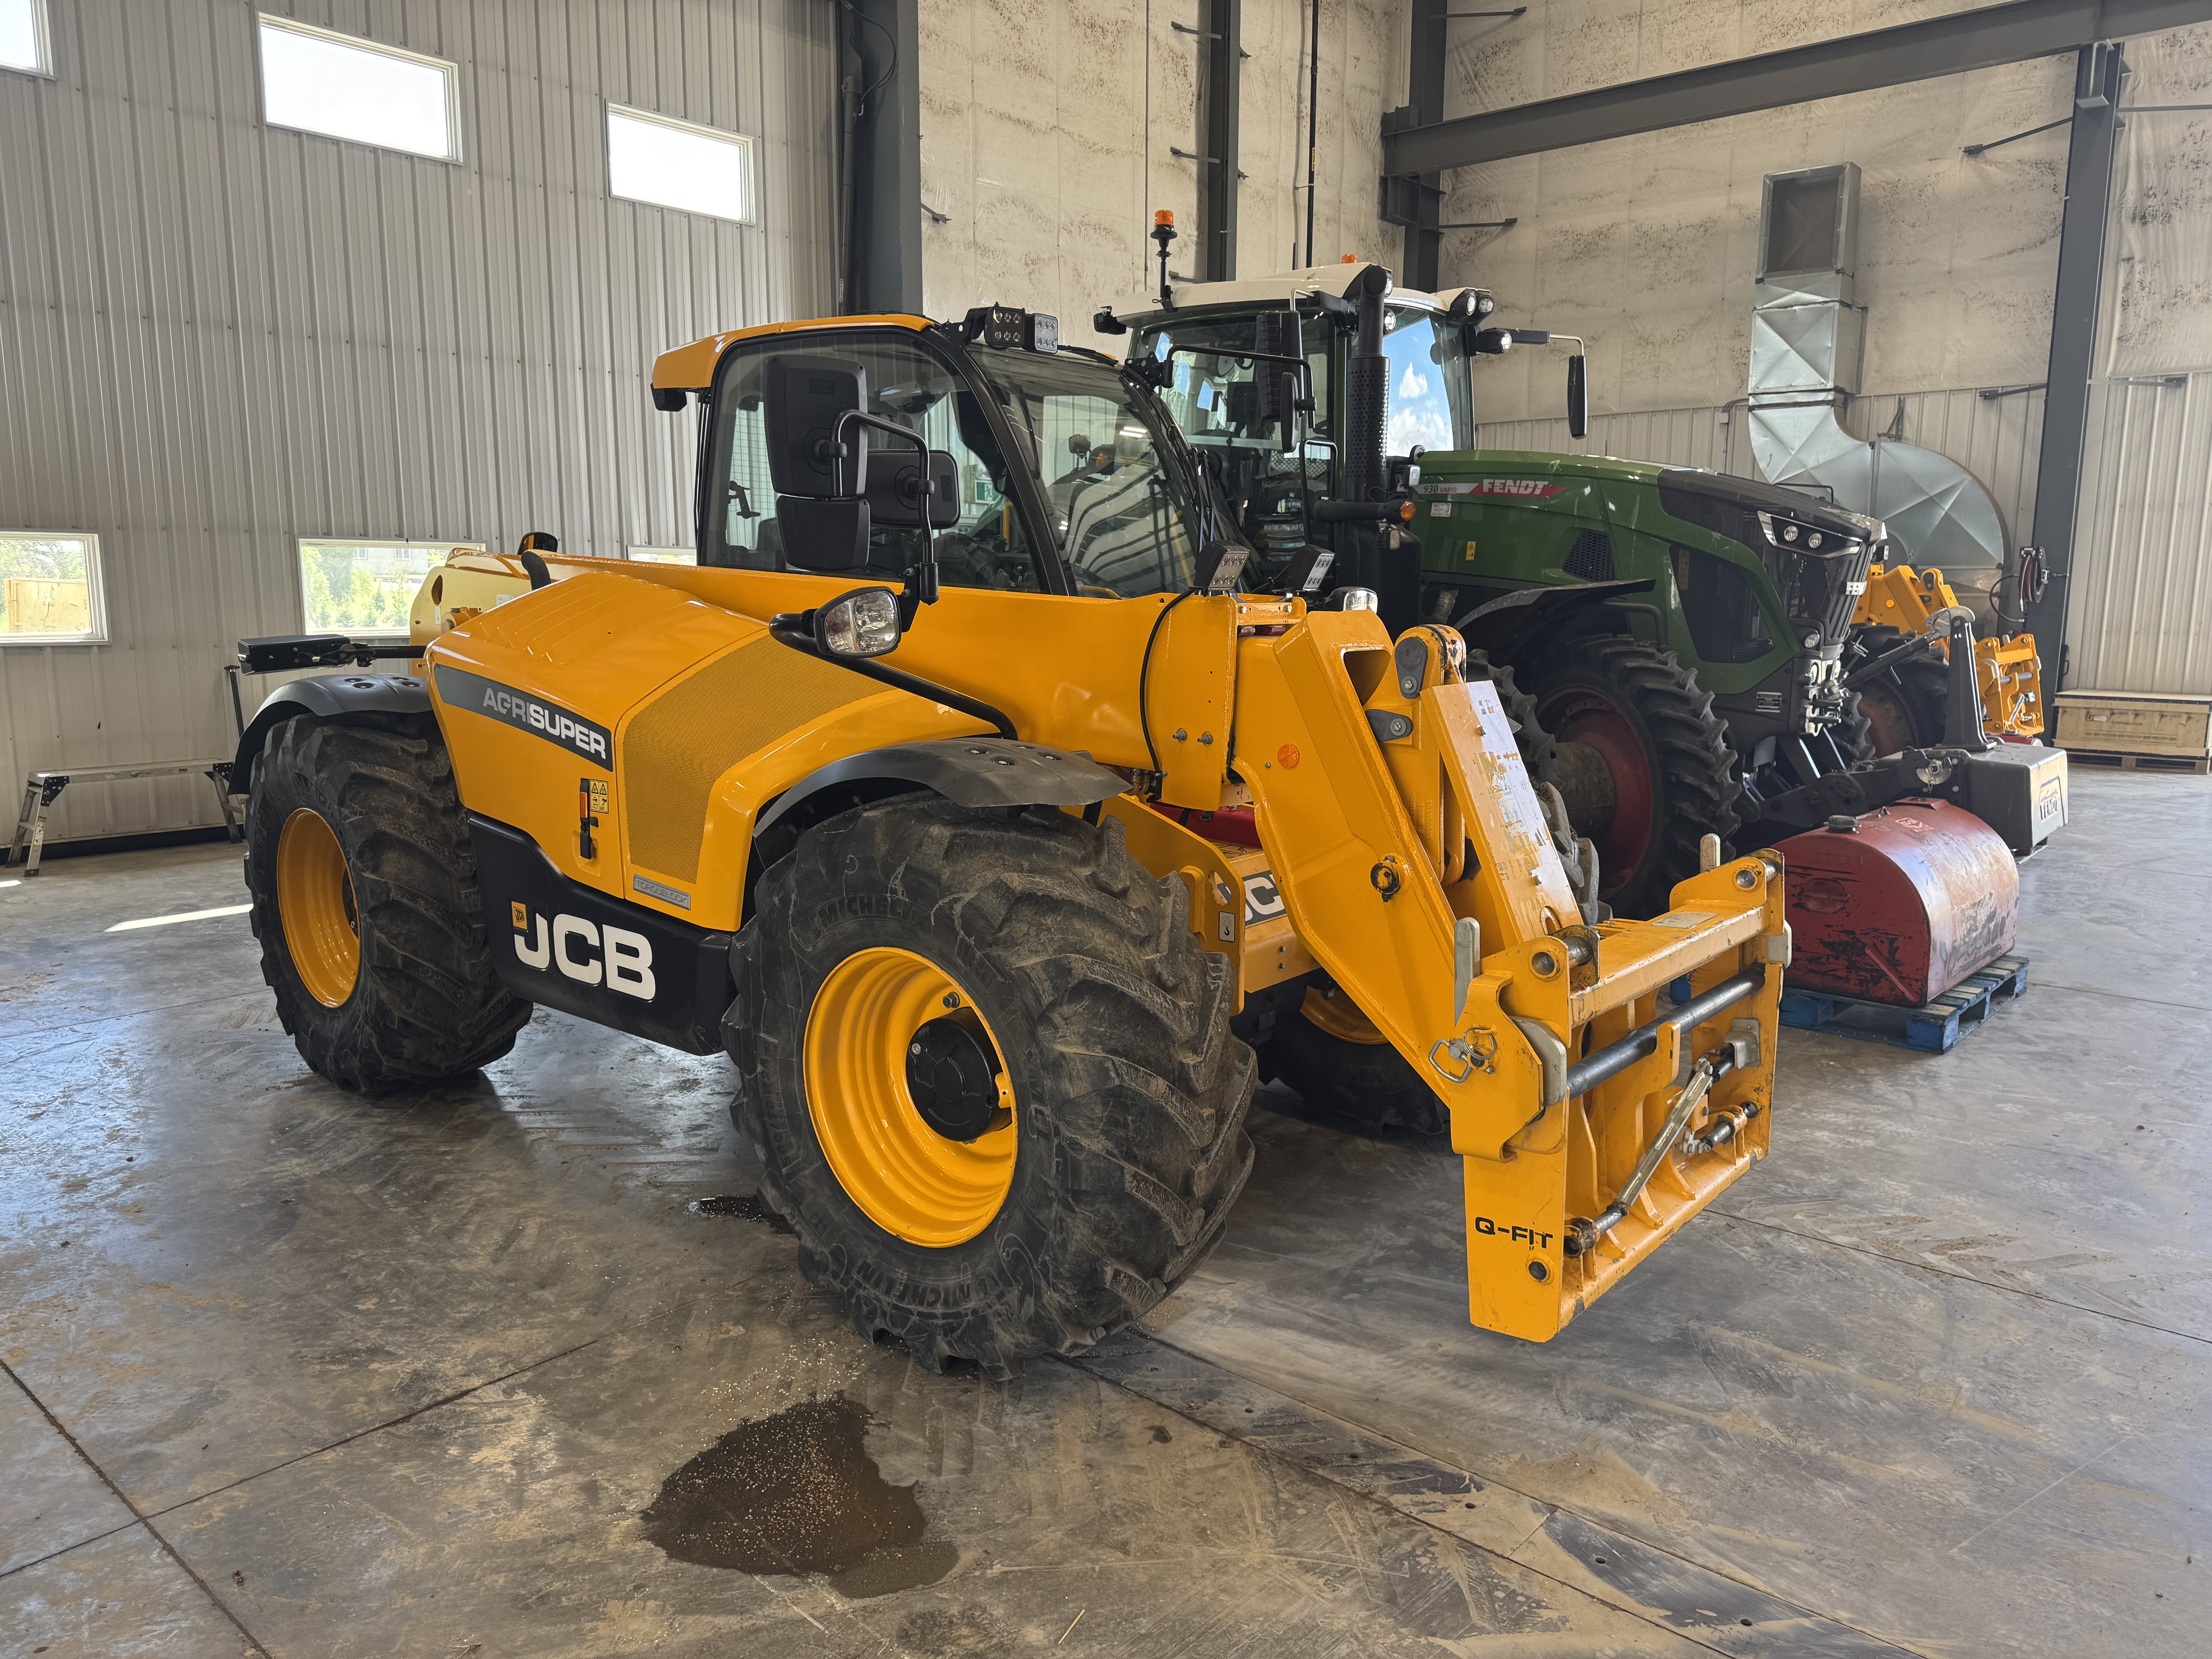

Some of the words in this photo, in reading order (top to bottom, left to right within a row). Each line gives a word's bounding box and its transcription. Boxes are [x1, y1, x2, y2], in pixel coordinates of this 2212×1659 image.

[1424, 485, 1438, 493] 930
[1483, 479, 1549, 495] FENDT
[483, 688, 606, 759] AGRISUPER
[636, 879, 687, 905] TORQUELOCK
[514, 912, 656, 1000] JCB
[1475, 1217, 1553, 1249] Q-FIT
